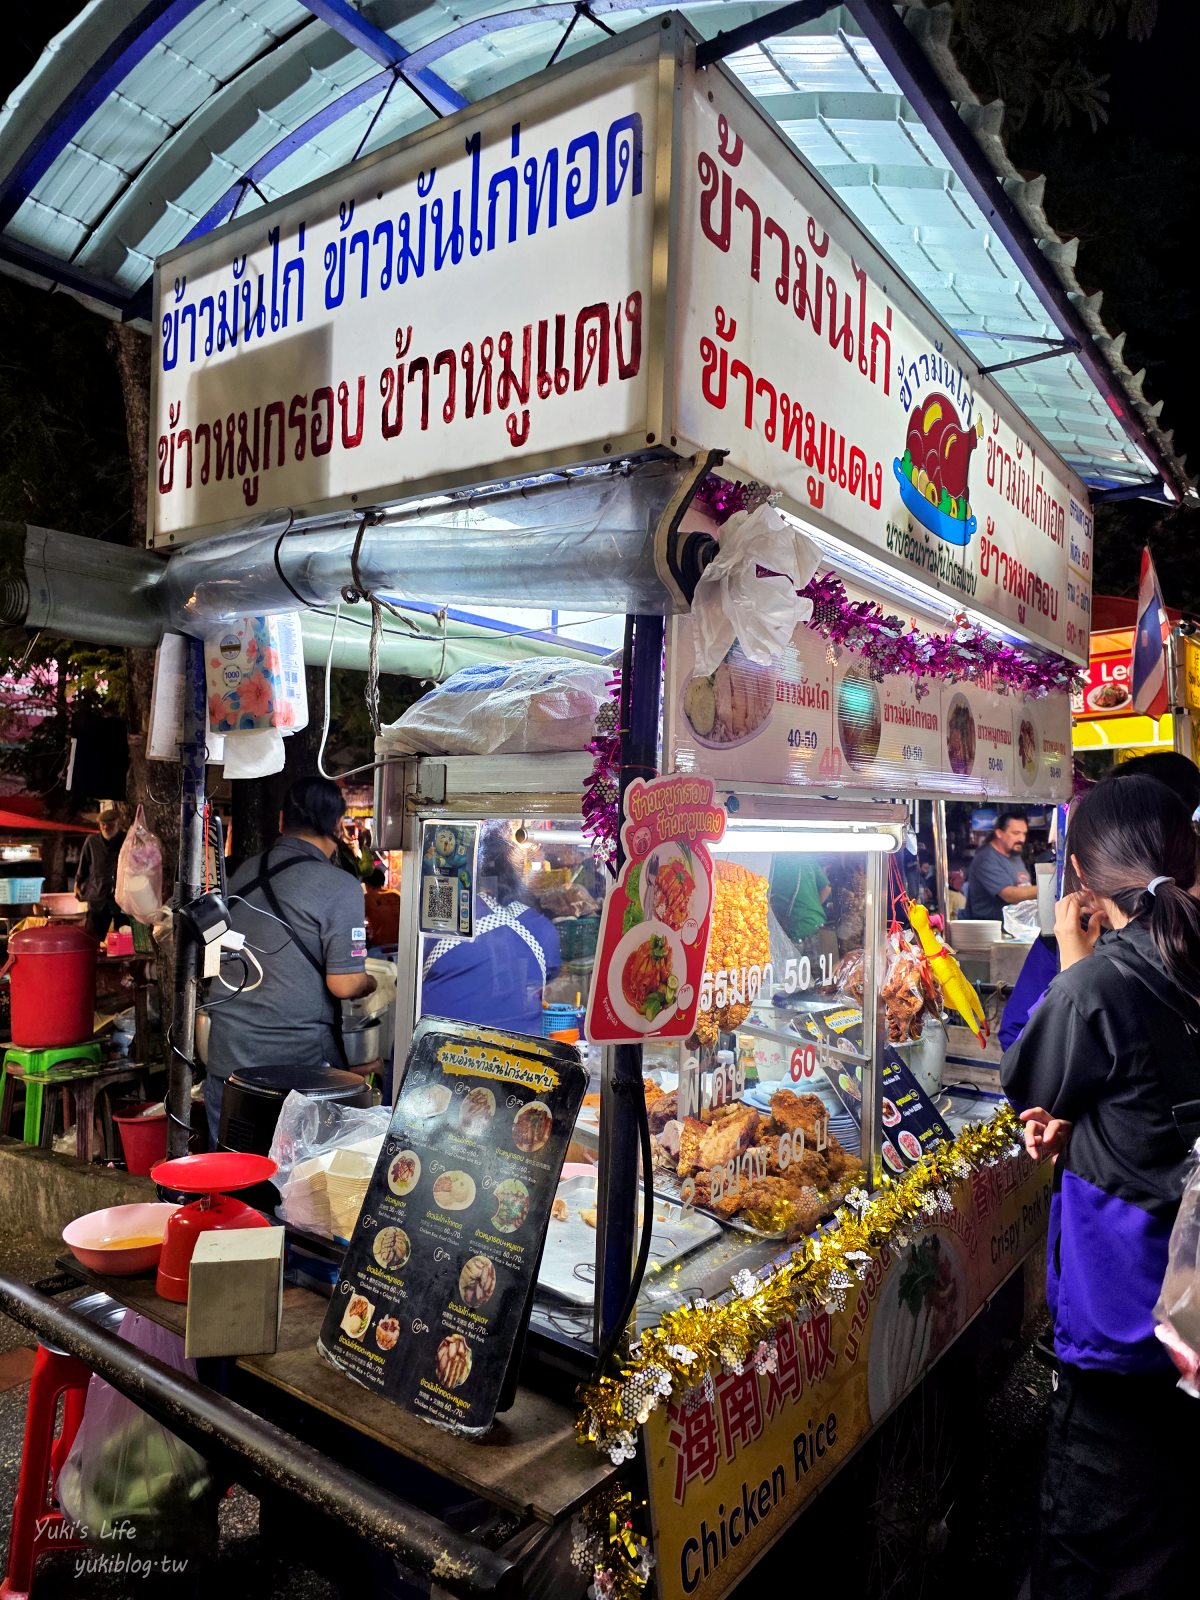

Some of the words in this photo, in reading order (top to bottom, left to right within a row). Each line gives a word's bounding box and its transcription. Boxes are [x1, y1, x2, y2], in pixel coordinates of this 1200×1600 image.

[163, 222, 306, 372] ข้าวมันไก่
[324, 111, 644, 310] ข้าวมันไก่ทอด
[699, 113, 893, 396] ข้าวมันไก่
[157, 374, 366, 507] ข้าวหมูกรอบ
[380, 290, 643, 448] ข้าวหมูแดง
[699, 304, 883, 511] ข้าวหมูแดง
[897, 340, 974, 427] ข้าวมันไก่
[987, 409, 1065, 549] ข้าวมันไก่ทอด
[1084, 513, 1093, 540] 50
[980, 515, 1059, 625] ข้าวหมูกรอบ
[1081, 551, 1090, 571] 60
[225, 671, 240, 679] 1000
[1101, 662, 1131, 682] Le
[787, 728, 818, 750] 40-50
[632, 786, 711, 822] ข้าวหมูกรอบ
[656, 809, 723, 842] ข้าวหมูแดง
[701, 962, 775, 1012] ธรรมดา
[784, 955, 811, 995] 50
[790, 1043, 816, 1083] 60
[680, 1177, 696, 1222] 2
[777, 1126, 805, 1170] 60
[990, 1216, 1020, 1264] Crispy
[1022, 1190, 1042, 1232] Pork
[1043, 1177, 1055, 1210] Ri
[359, 1280, 372, 1291] Chicken
[371, 1286, 379, 1294] Rice
[381, 1291, 392, 1301] Crispy
[441, 1318, 456, 1330] Chicken
[456, 1326, 464, 1334] Rice
[467, 1331, 475, 1339] Red
[475, 1335, 485, 1344] Pork
[366, 1371, 377, 1383] Crispy
[414, 1397, 429, 1410] Chicken
[666, 1301, 837, 1504] 海南鸡饭
[680, 1462, 786, 1596] Chicken
[793, 1410, 838, 1484] Rice
